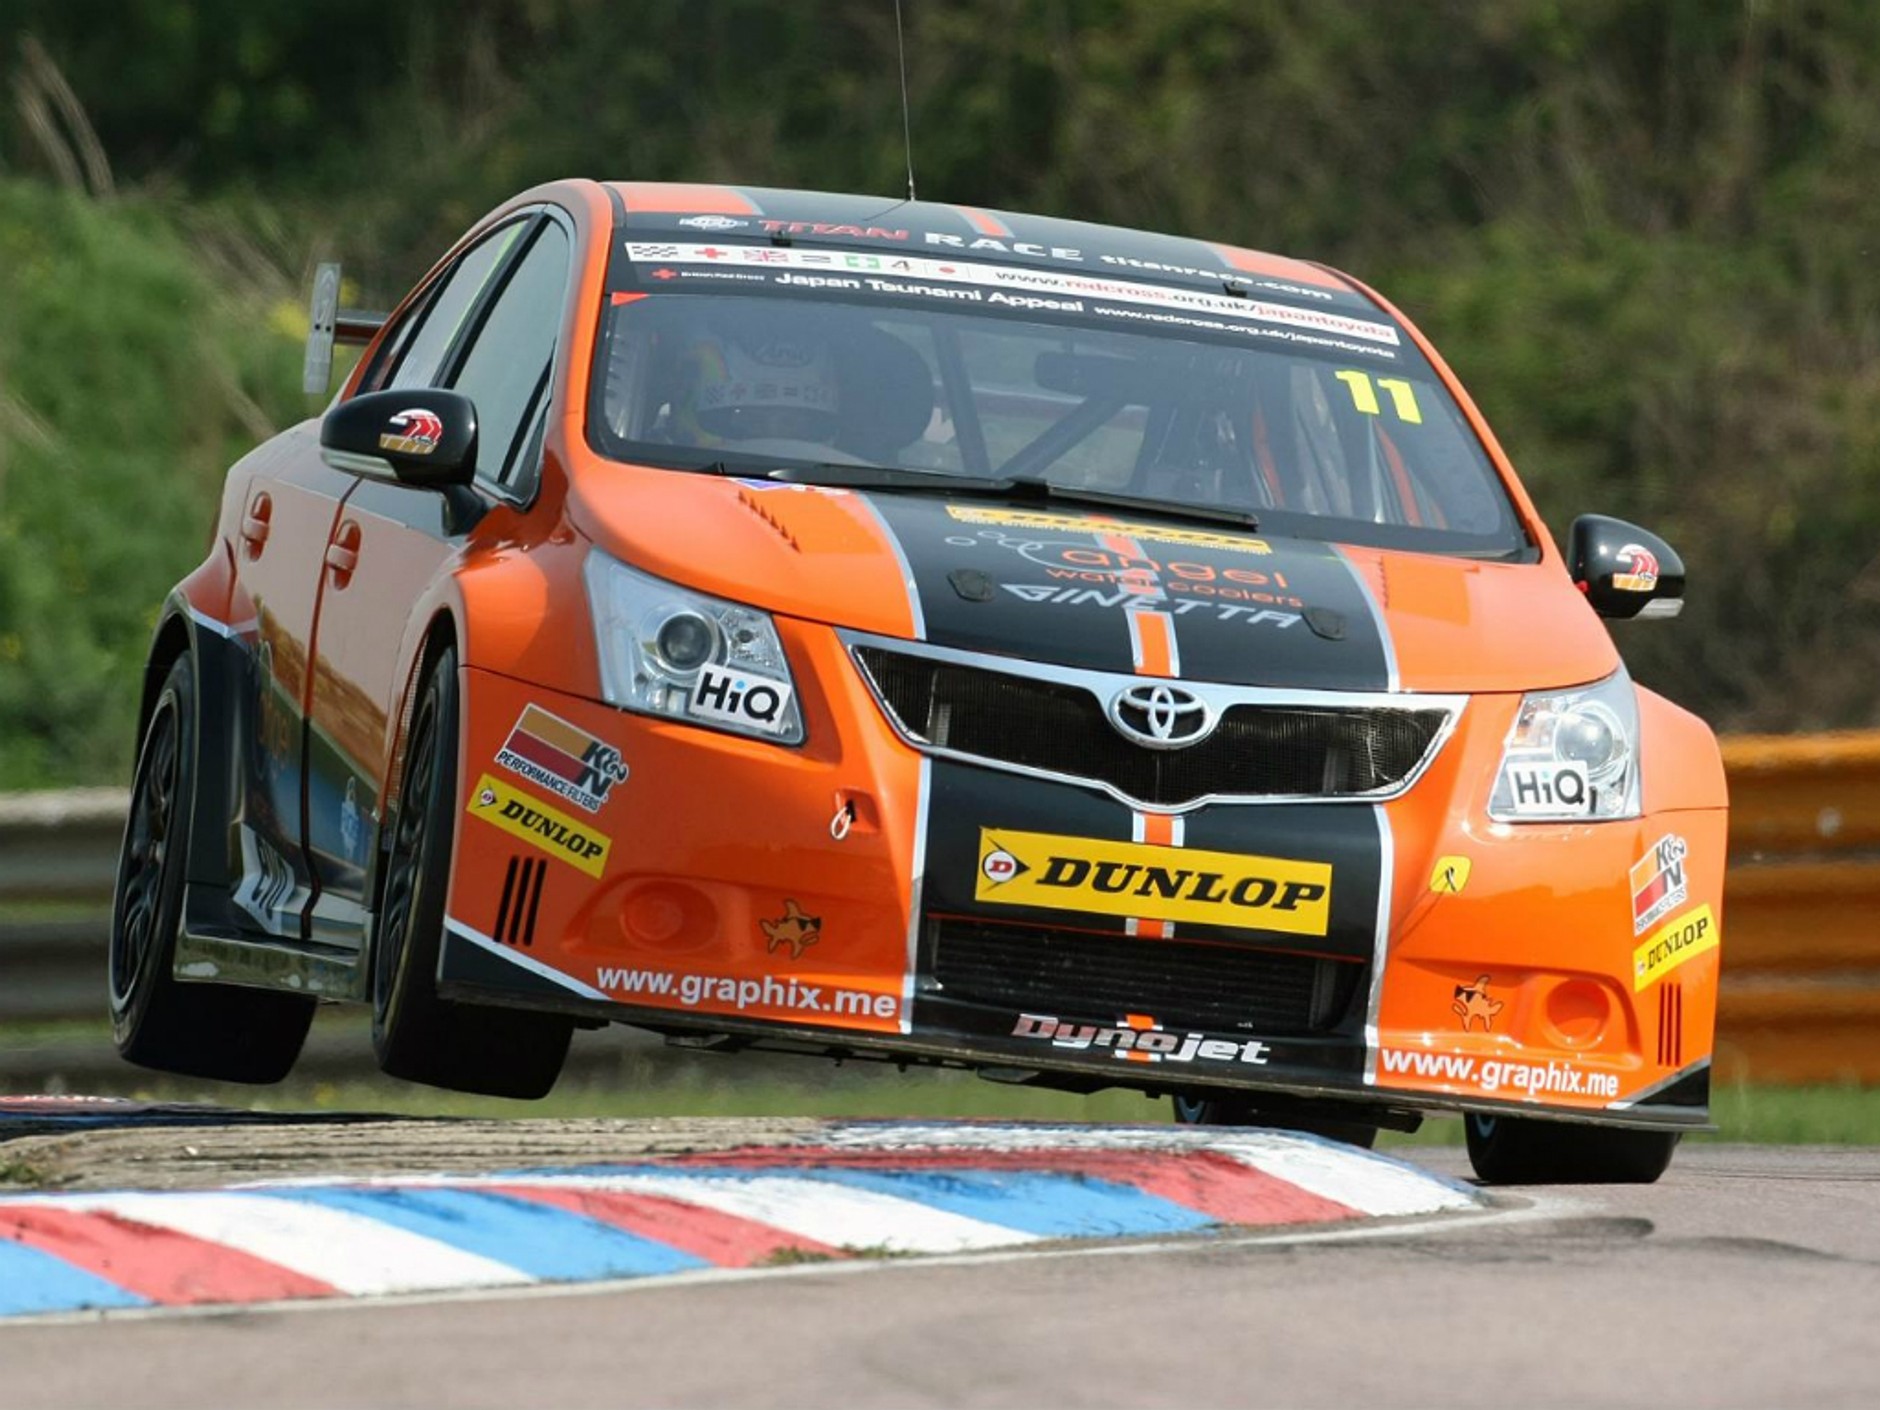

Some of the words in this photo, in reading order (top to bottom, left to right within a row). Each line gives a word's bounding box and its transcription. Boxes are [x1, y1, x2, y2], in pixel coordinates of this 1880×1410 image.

[759, 219, 909, 241] TITAN
[925, 232, 1083, 261] RACE
[775, 272, 860, 288] Japan
[865, 279, 982, 300] Tsunami
[988, 291, 1084, 312] Appeal
[1335, 370, 1422, 425] 11
[1046, 569, 1155, 592] water
[1167, 581, 1303, 607] coolers
[1062, 549, 1288, 589] angel
[1001, 584, 1302, 628] GINETTA
[696, 672, 780, 724] HiQ
[498, 750, 568, 795] PERFORMANCE
[1514, 768, 1585, 806] HiQ
[499, 799, 604, 859] DUNLOP
[1035, 856, 1326, 911] DUNLOP
[1647, 916, 1708, 971] DUNLOP
[596, 965, 898, 1018] www.graphix.me
[1011, 1013, 1271, 1064] Dynojet
[1381, 1048, 1619, 1097] www.graphix.me
